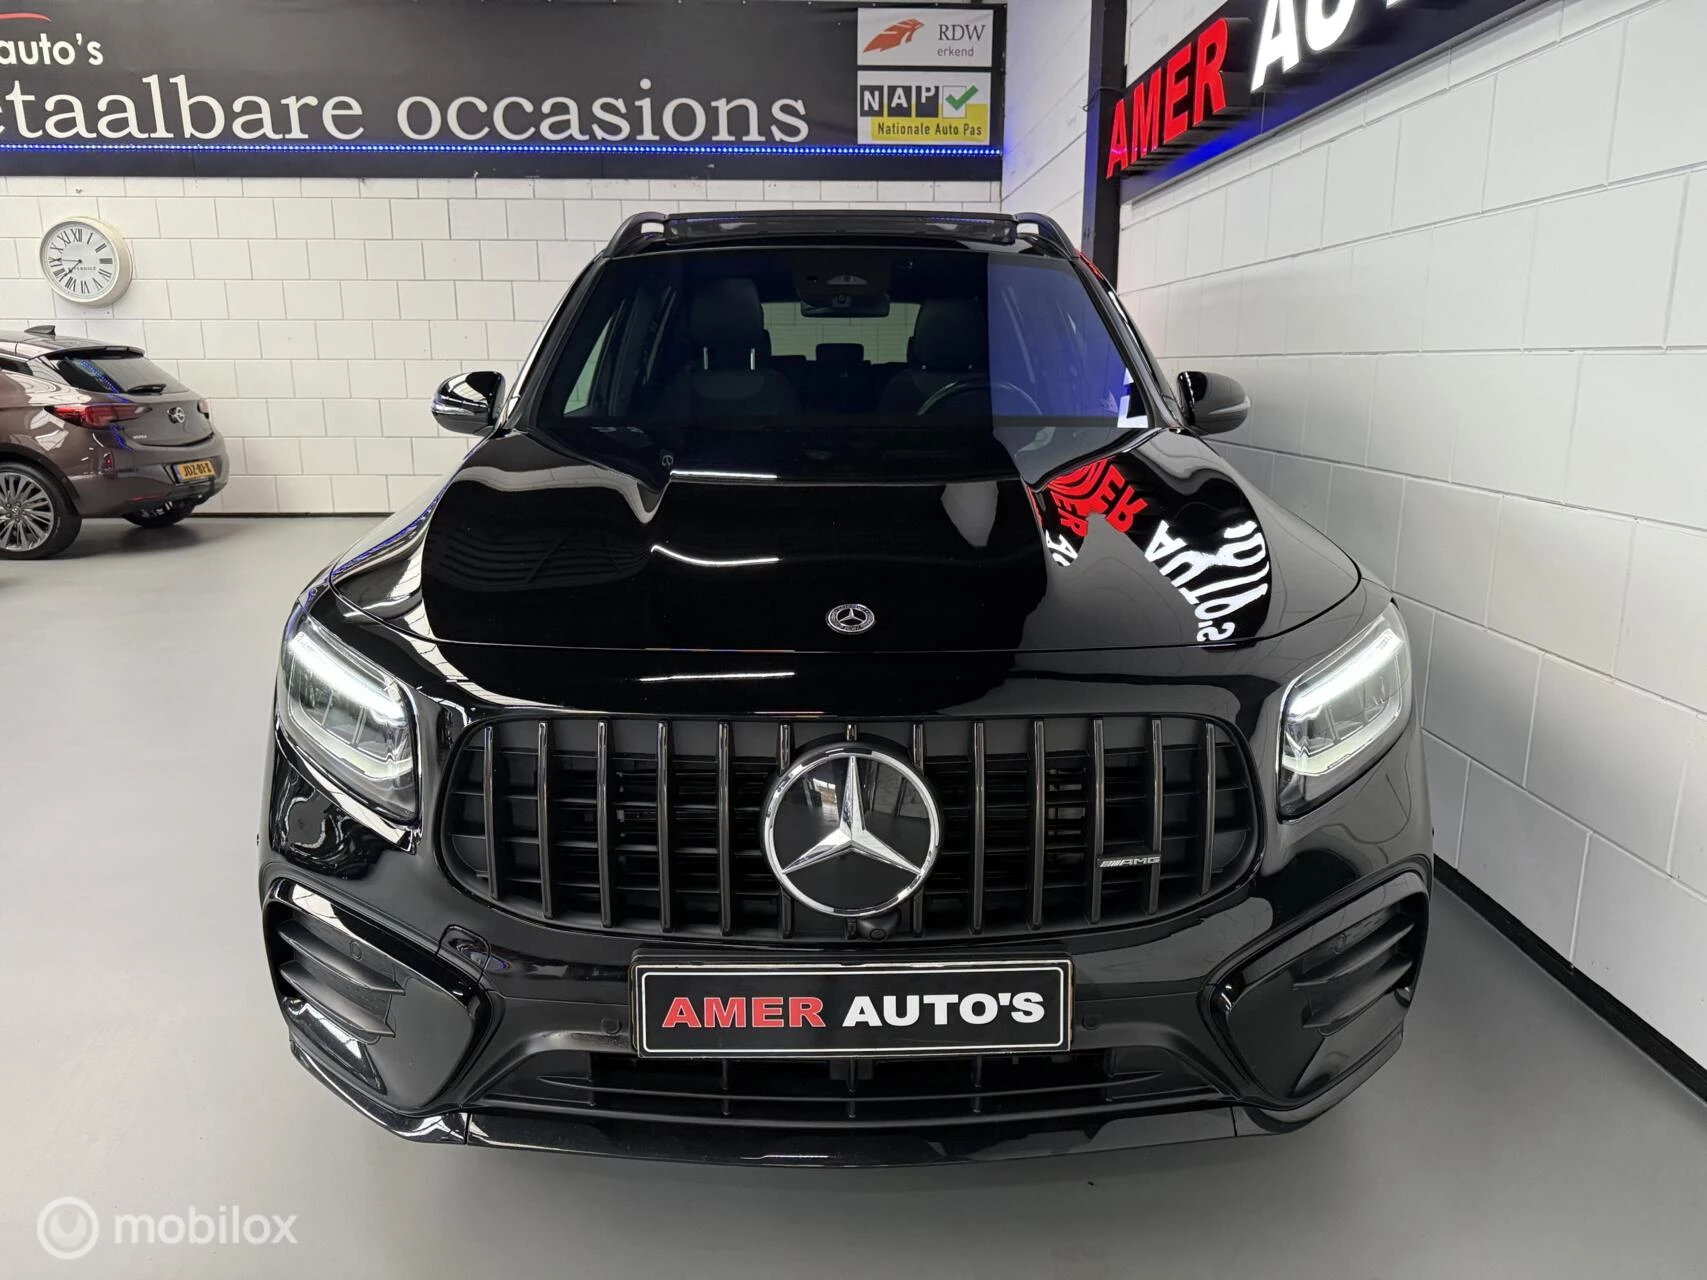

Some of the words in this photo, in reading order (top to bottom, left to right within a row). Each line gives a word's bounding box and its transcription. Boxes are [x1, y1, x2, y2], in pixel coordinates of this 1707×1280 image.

[938, 24, 986, 41] RDW
[0, 33, 104, 65] auto's
[937, 46, 974, 57] erkend
[0, 74, 364, 140] taalbare
[397, 78, 809, 142] occasions
[1106, 17, 1228, 179] AMER
[878, 122, 930, 135] Nationale
[935, 123, 959, 135] Auto
[964, 123, 983, 136] Pas
[1119, 856, 1160, 867] AMG
[662, 996, 826, 1028] AMER
[842, 991, 1045, 1027] AUTO'S
